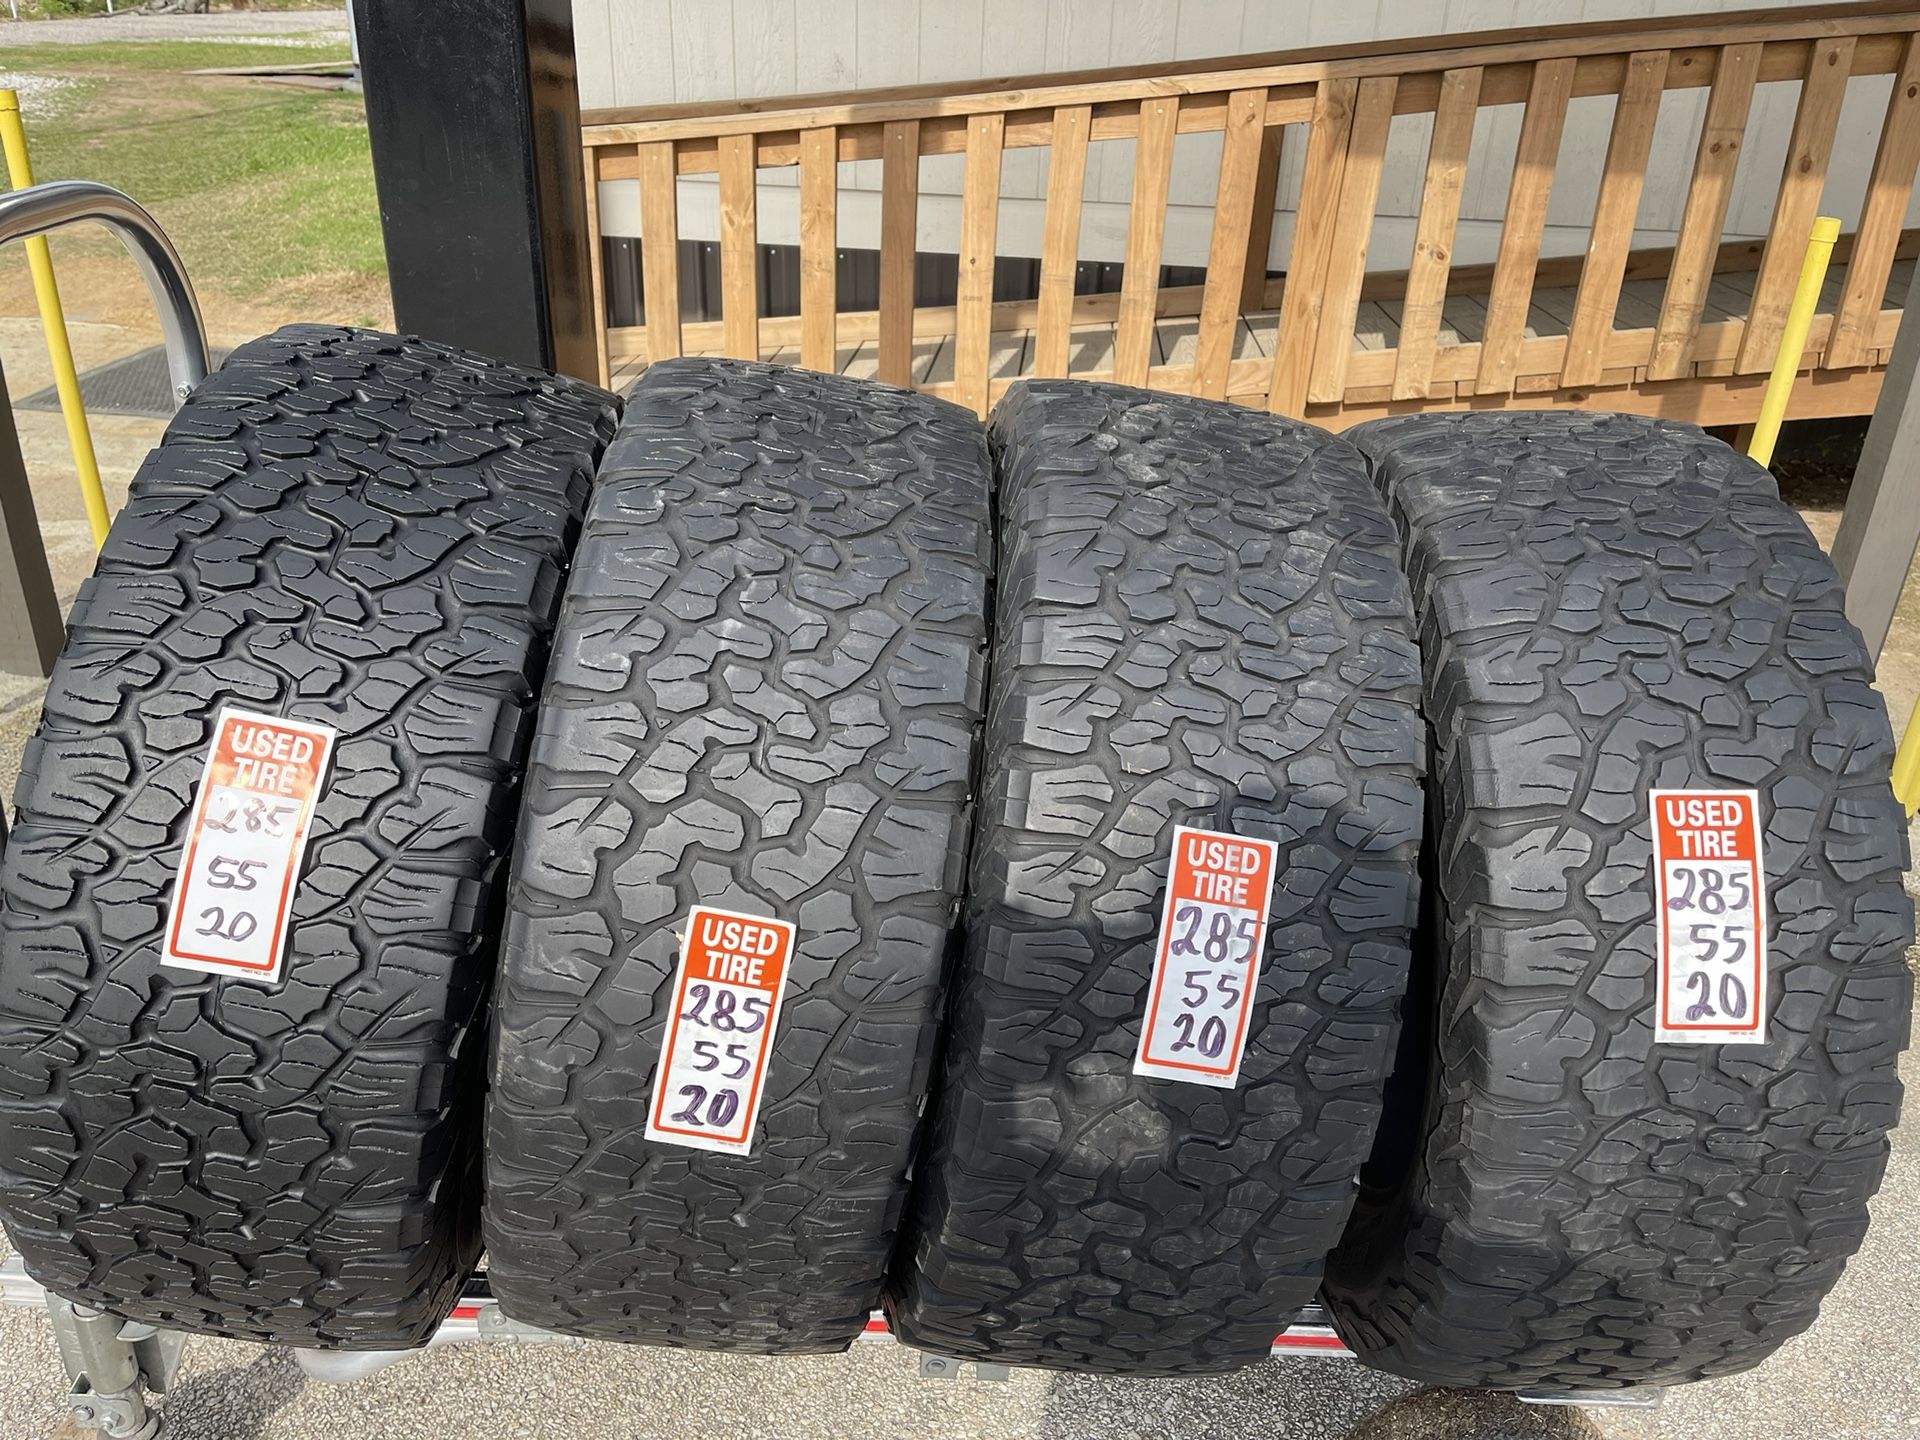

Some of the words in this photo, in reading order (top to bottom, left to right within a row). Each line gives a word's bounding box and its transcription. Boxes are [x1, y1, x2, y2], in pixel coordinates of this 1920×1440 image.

[231, 725, 313, 764] USED
[233, 757, 298, 794] TIRE
[204, 793, 298, 838] 285
[1665, 799, 1743, 827] USED
[1187, 838, 1261, 875] USED
[1676, 830, 1738, 857] TIRE
[207, 855, 268, 891] 55
[1192, 870, 1249, 905] TIRE
[1667, 868, 1750, 915] 285
[195, 907, 258, 942] 20
[702, 918, 778, 956] USED
[1171, 906, 1266, 964] 285
[1689, 924, 1747, 964] 55
[705, 950, 765, 986] TIRE
[680, 984, 772, 1033] 285
[1181, 970, 1240, 1010] 55
[1685, 971, 1747, 1021] 20
[1170, 1013, 1227, 1058] 20
[692, 1040, 751, 1080] 55
[670, 1084, 739, 1127] 20
